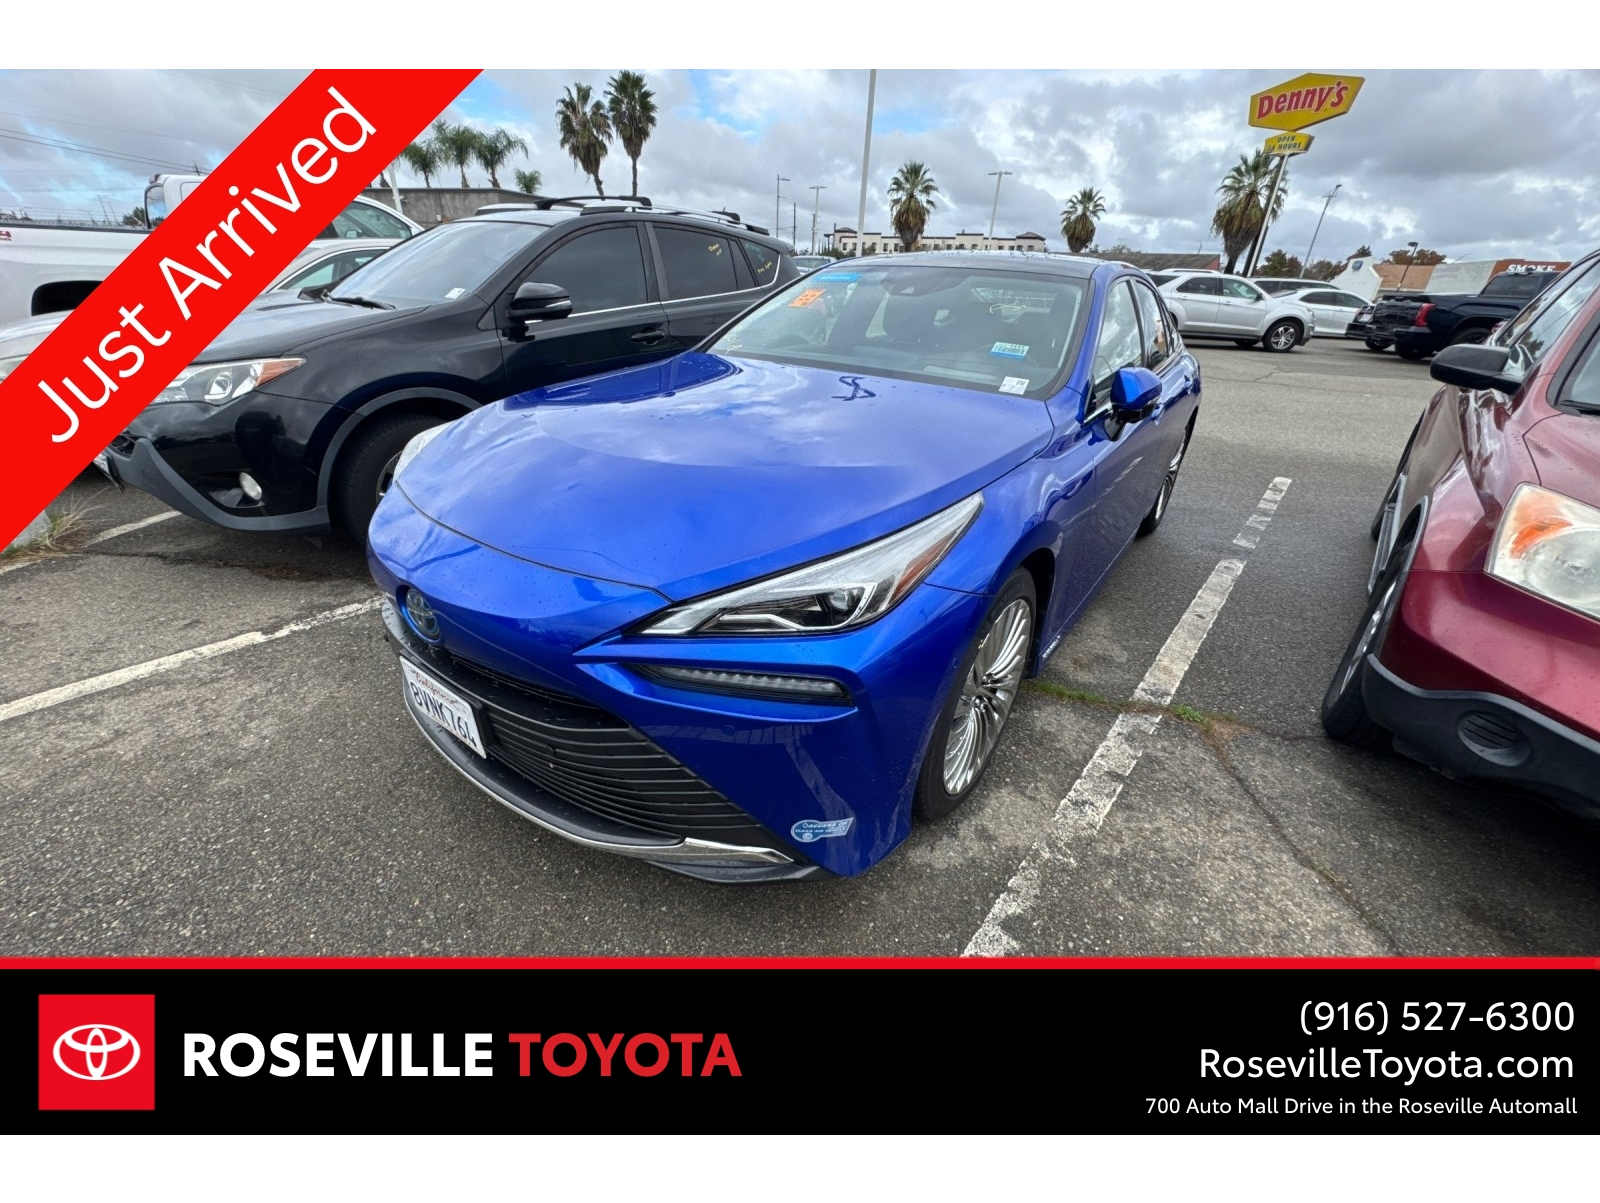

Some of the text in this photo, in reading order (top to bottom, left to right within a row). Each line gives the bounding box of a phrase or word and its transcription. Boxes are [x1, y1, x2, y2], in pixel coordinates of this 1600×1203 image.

[1257, 81, 1349, 119] Denny's
[1506, 263, 1557, 273] SMOKE
[409, 681, 478, 747] 8VNK764
